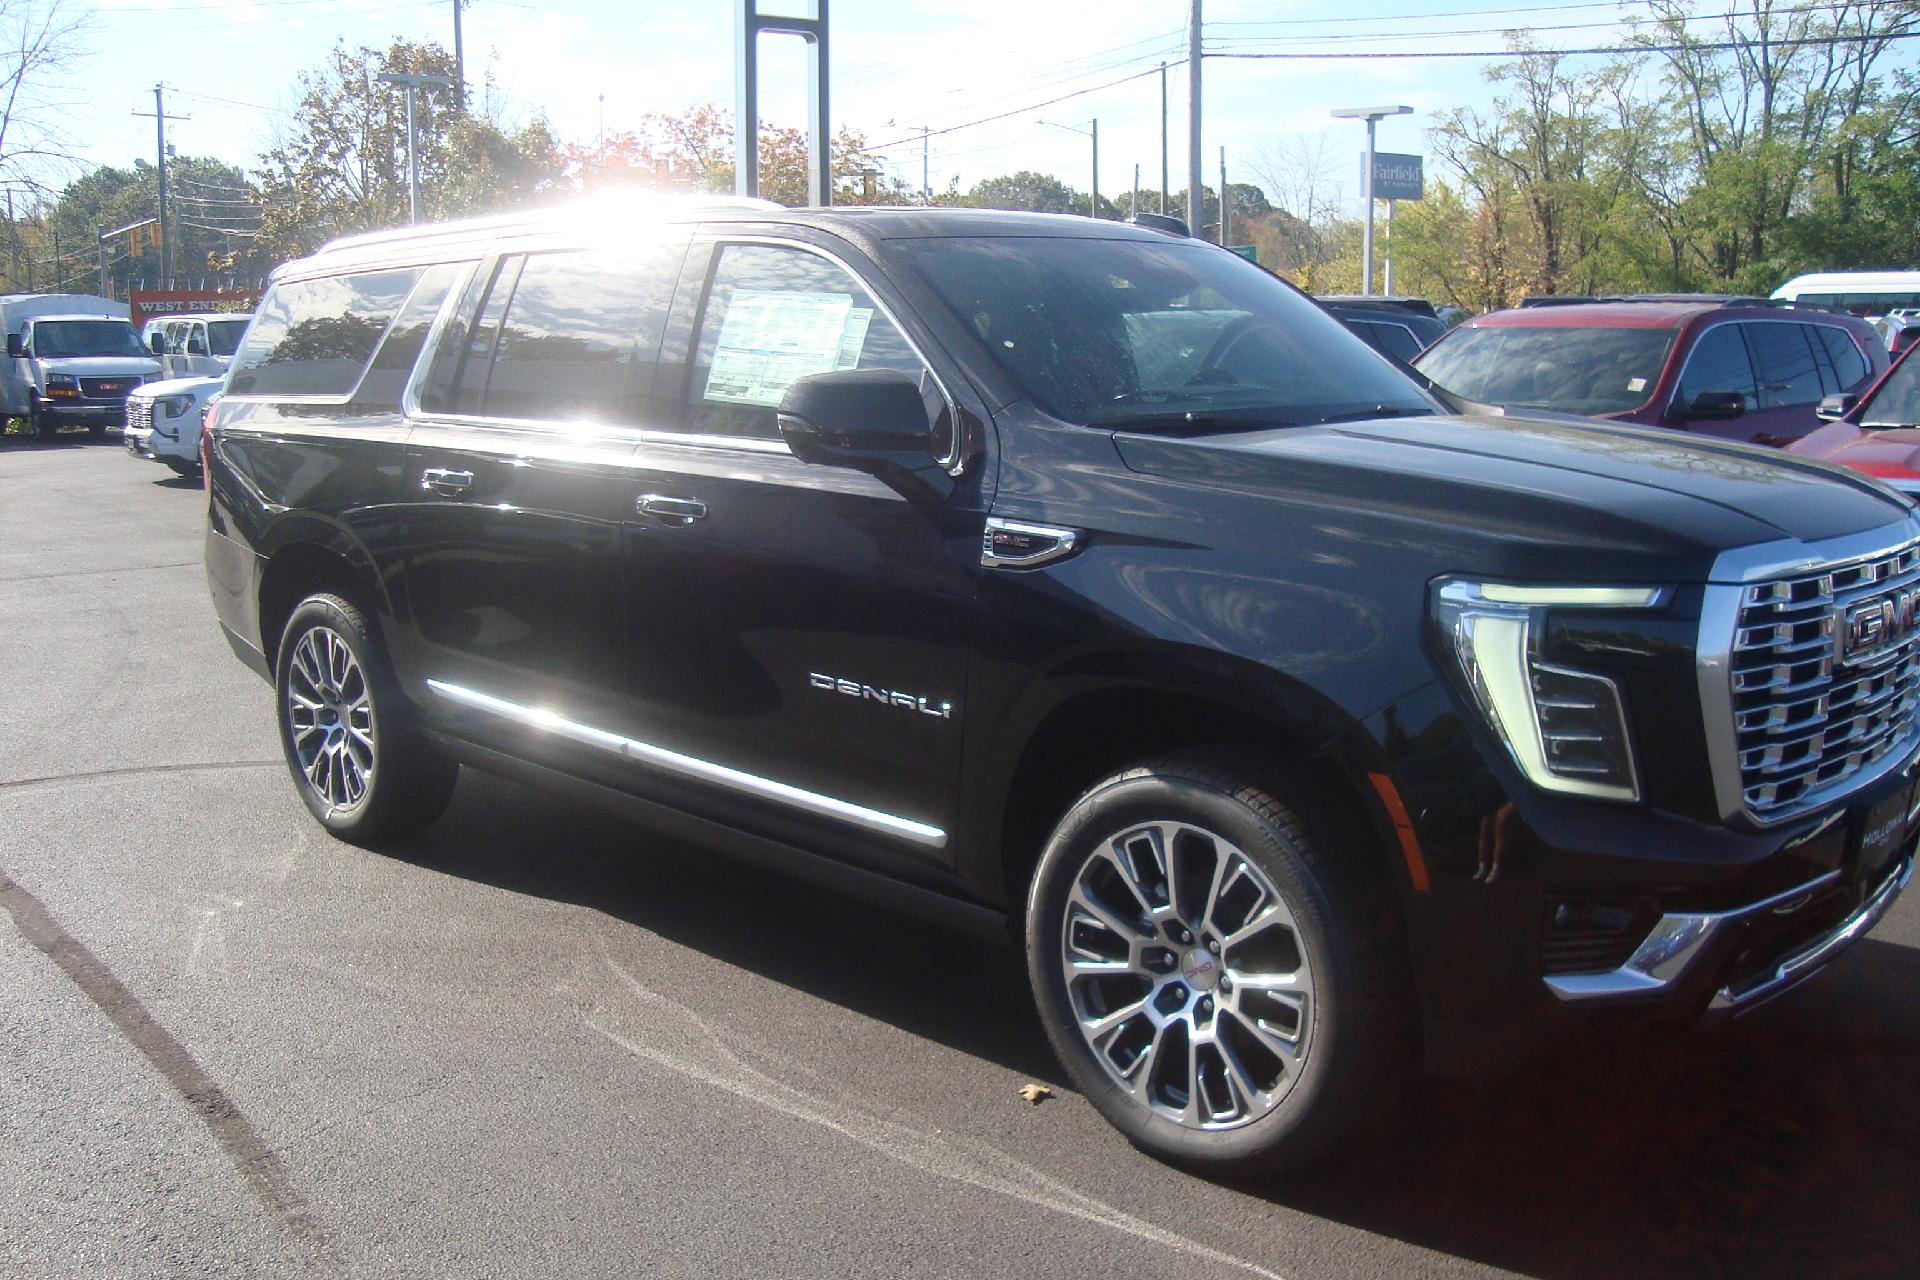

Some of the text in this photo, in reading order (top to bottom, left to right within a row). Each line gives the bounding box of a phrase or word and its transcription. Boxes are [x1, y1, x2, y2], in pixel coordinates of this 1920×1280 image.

[1373, 163, 1419, 181] Fairfield
[139, 301, 184, 312] WEST
[810, 672, 951, 719] DENALI
